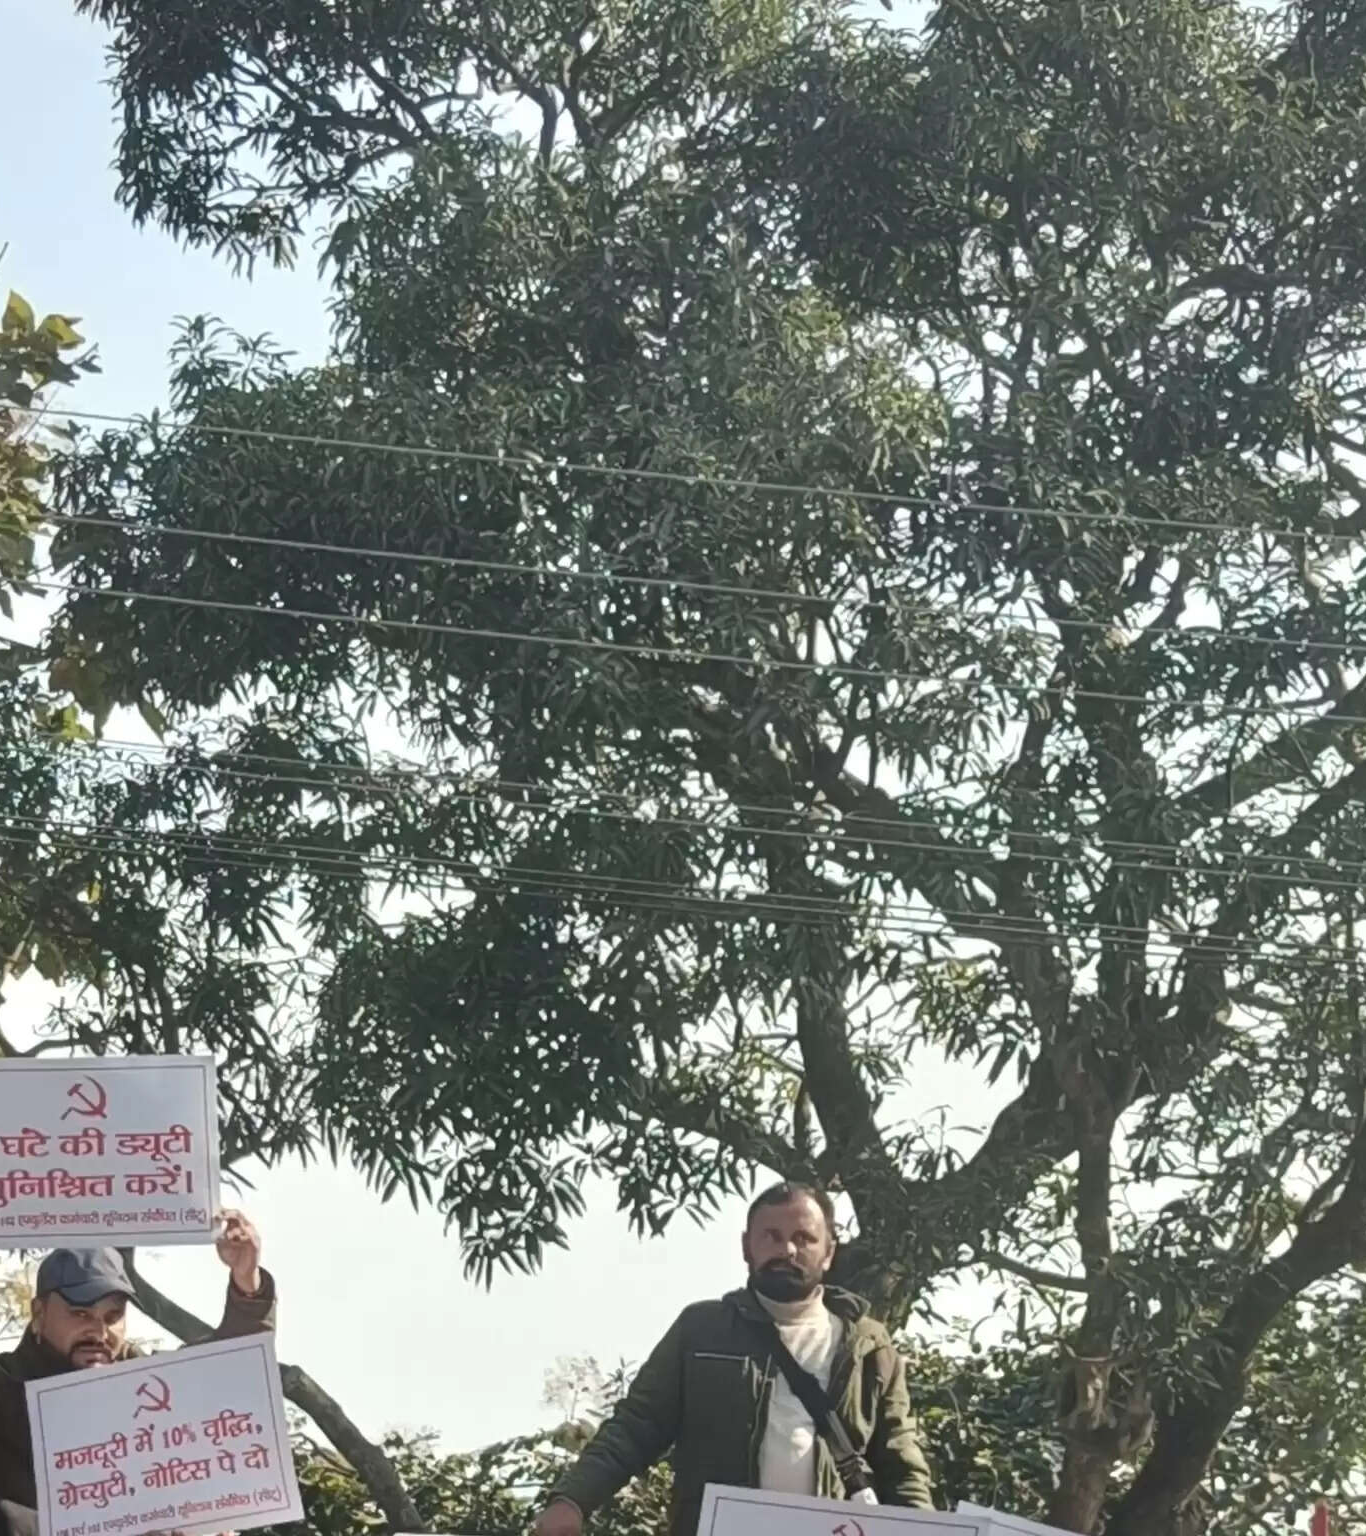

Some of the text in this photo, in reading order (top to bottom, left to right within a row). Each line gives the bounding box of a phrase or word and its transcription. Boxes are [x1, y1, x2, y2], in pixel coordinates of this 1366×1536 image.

[0, 1127, 51, 1158] घंटे
[57, 1127, 107, 1157] की
[115, 1124, 193, 1162] ड्यूटी
[123, 1164, 194, 1196] करें।
[53, 1409, 263, 1470] मजदूरी में 10% वृद्धि,
[57, 1443, 270, 1510] ग्रेच्युटी, नोटिस पे दो
